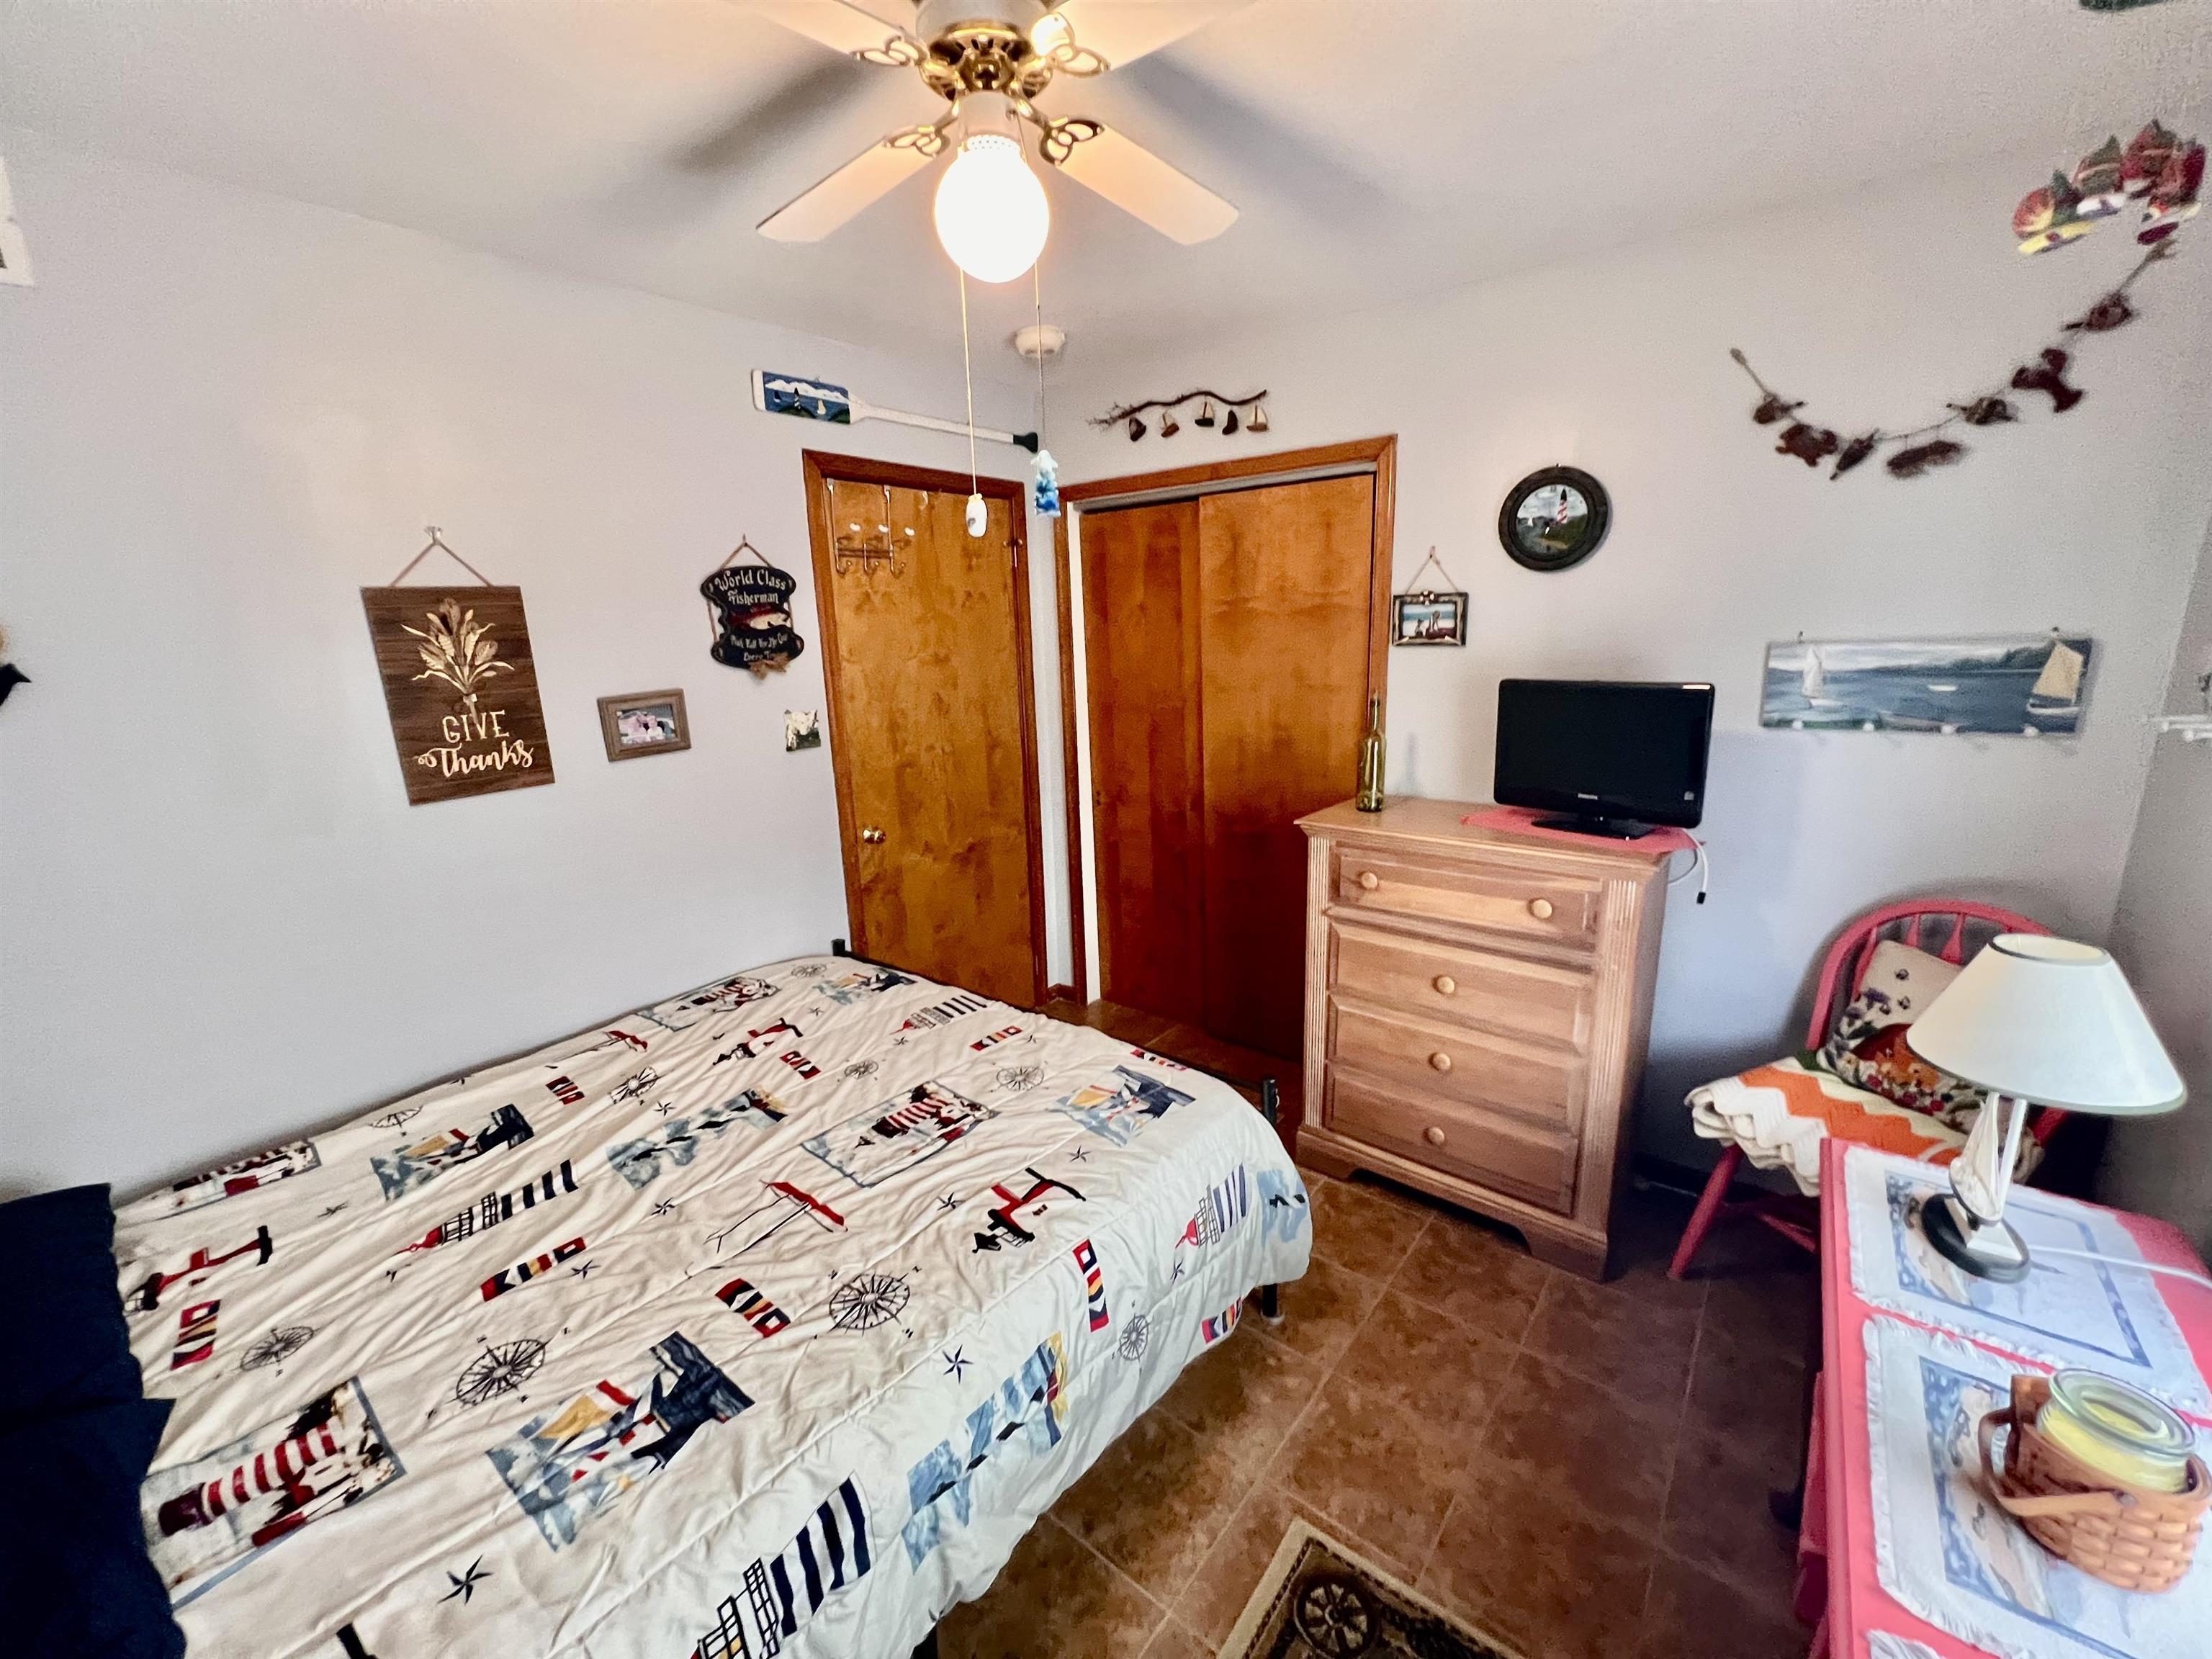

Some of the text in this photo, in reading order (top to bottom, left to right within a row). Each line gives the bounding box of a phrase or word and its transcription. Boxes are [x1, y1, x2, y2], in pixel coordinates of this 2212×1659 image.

[714, 569, 786, 591] World Class
[727, 589, 779, 606] Fisherman
[441, 709, 510, 743] GIVE
[418, 739, 534, 778] Thanks
